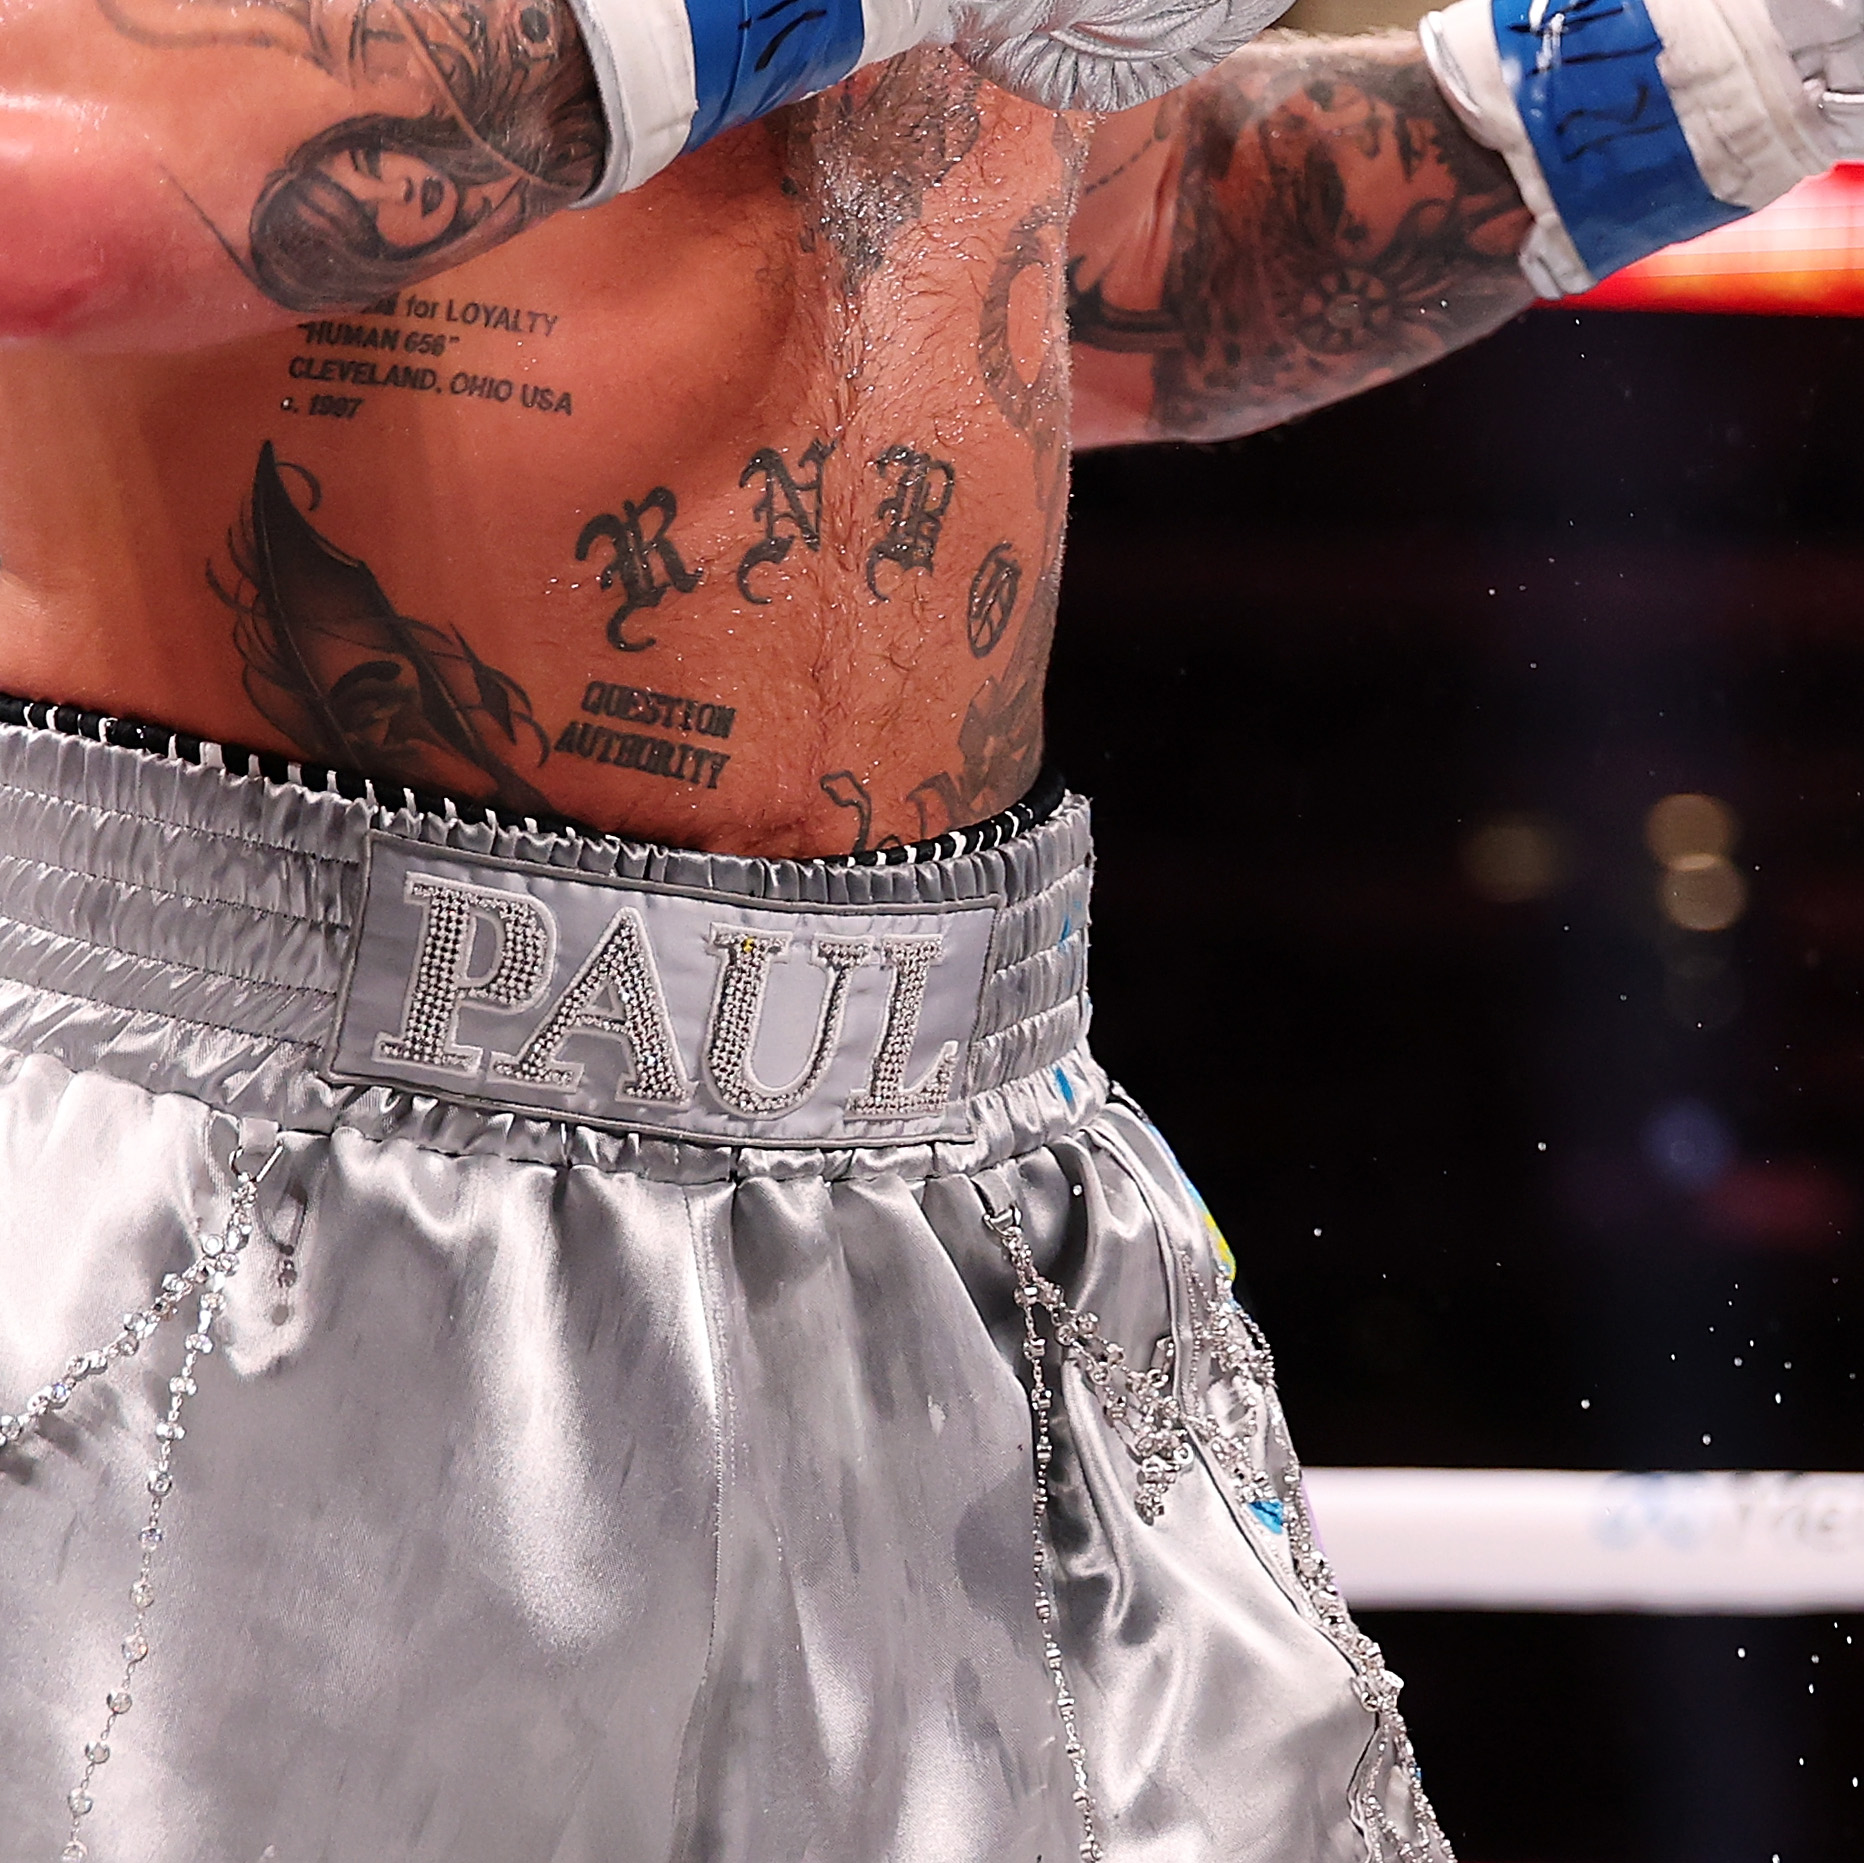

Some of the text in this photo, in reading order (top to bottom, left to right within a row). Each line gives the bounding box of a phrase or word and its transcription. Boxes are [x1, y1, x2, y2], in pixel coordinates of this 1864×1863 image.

[405, 294, 439, 318] for
[445, 298, 558, 337] LOYALTY
[450, 371, 513, 402] OHIO
[521, 383, 573, 416] USA
[581, 680, 737, 740] QUESTION
[554, 720, 731, 790] AUTHORITY
[373, 871, 960, 1122] PAUL
